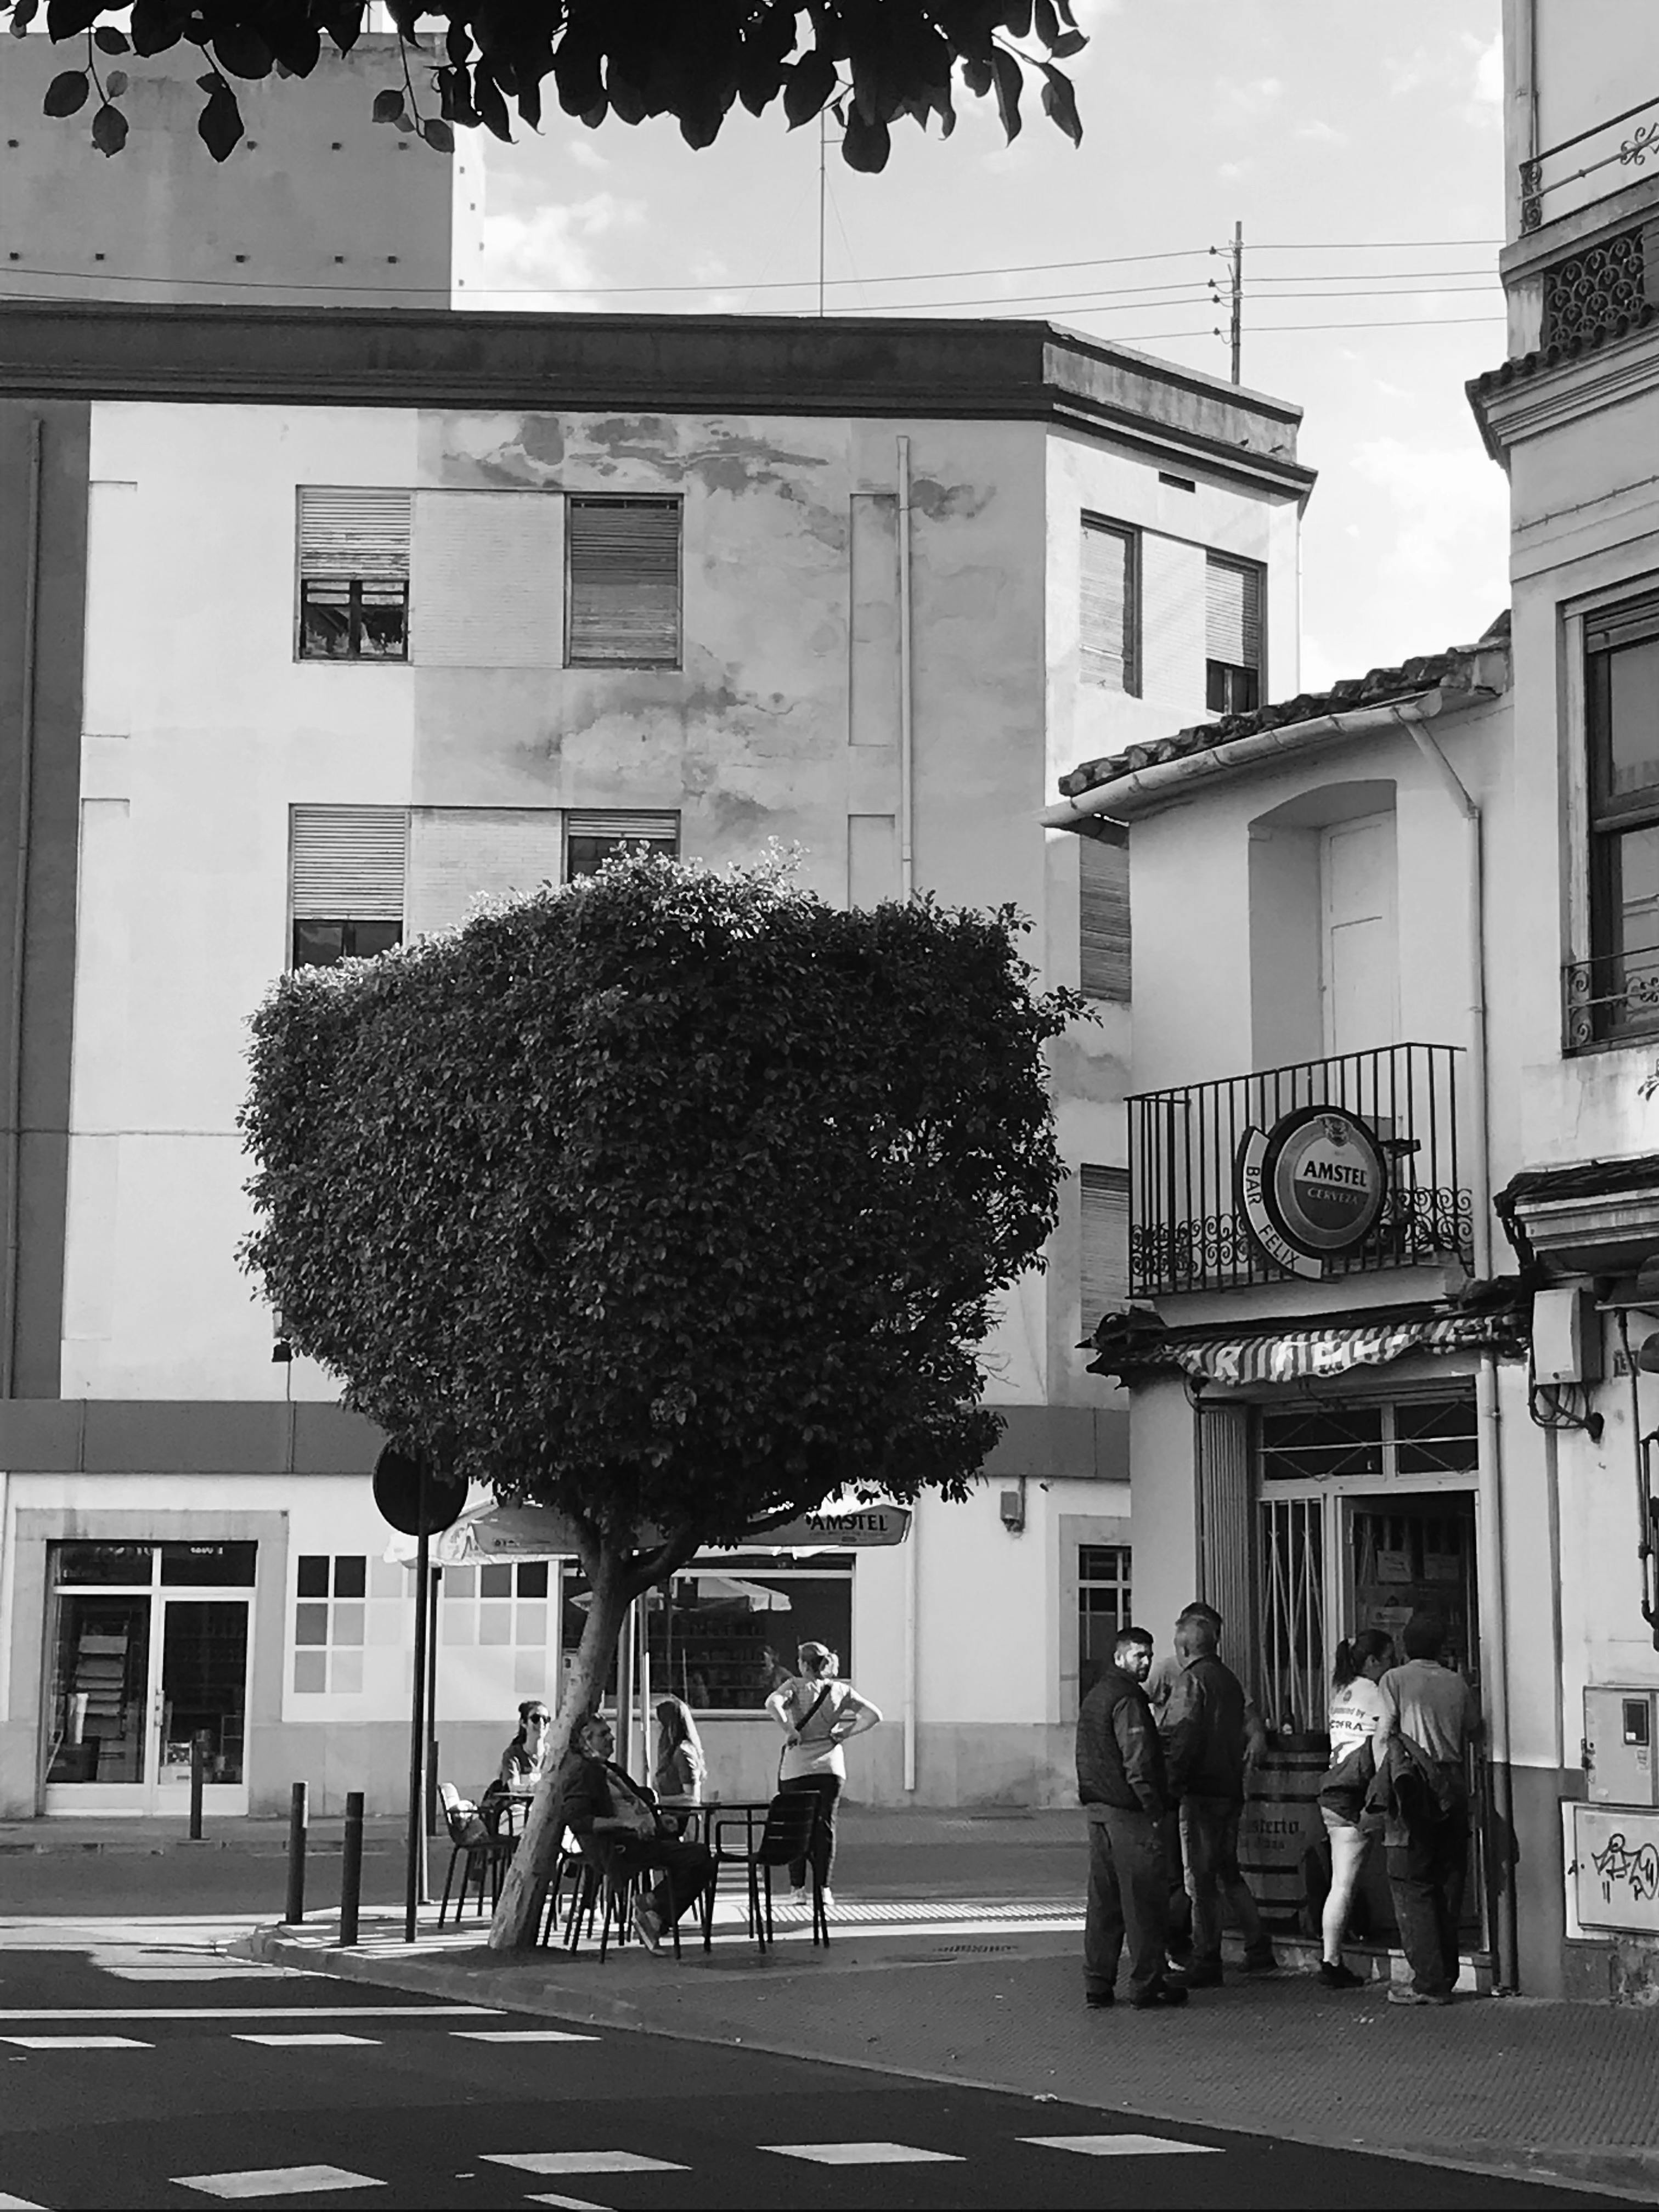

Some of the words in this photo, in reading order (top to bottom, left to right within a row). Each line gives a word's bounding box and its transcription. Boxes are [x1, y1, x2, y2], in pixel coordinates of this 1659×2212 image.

[1304, 1160, 1367, 1187] AMSTEL
[1307, 1187, 1358, 1204] CERVEZA
[1246, 1166, 1262, 1205] BAR
[1259, 1224, 1300, 1271] FELIX
[810, 1513, 888, 1531] AMSTEL
